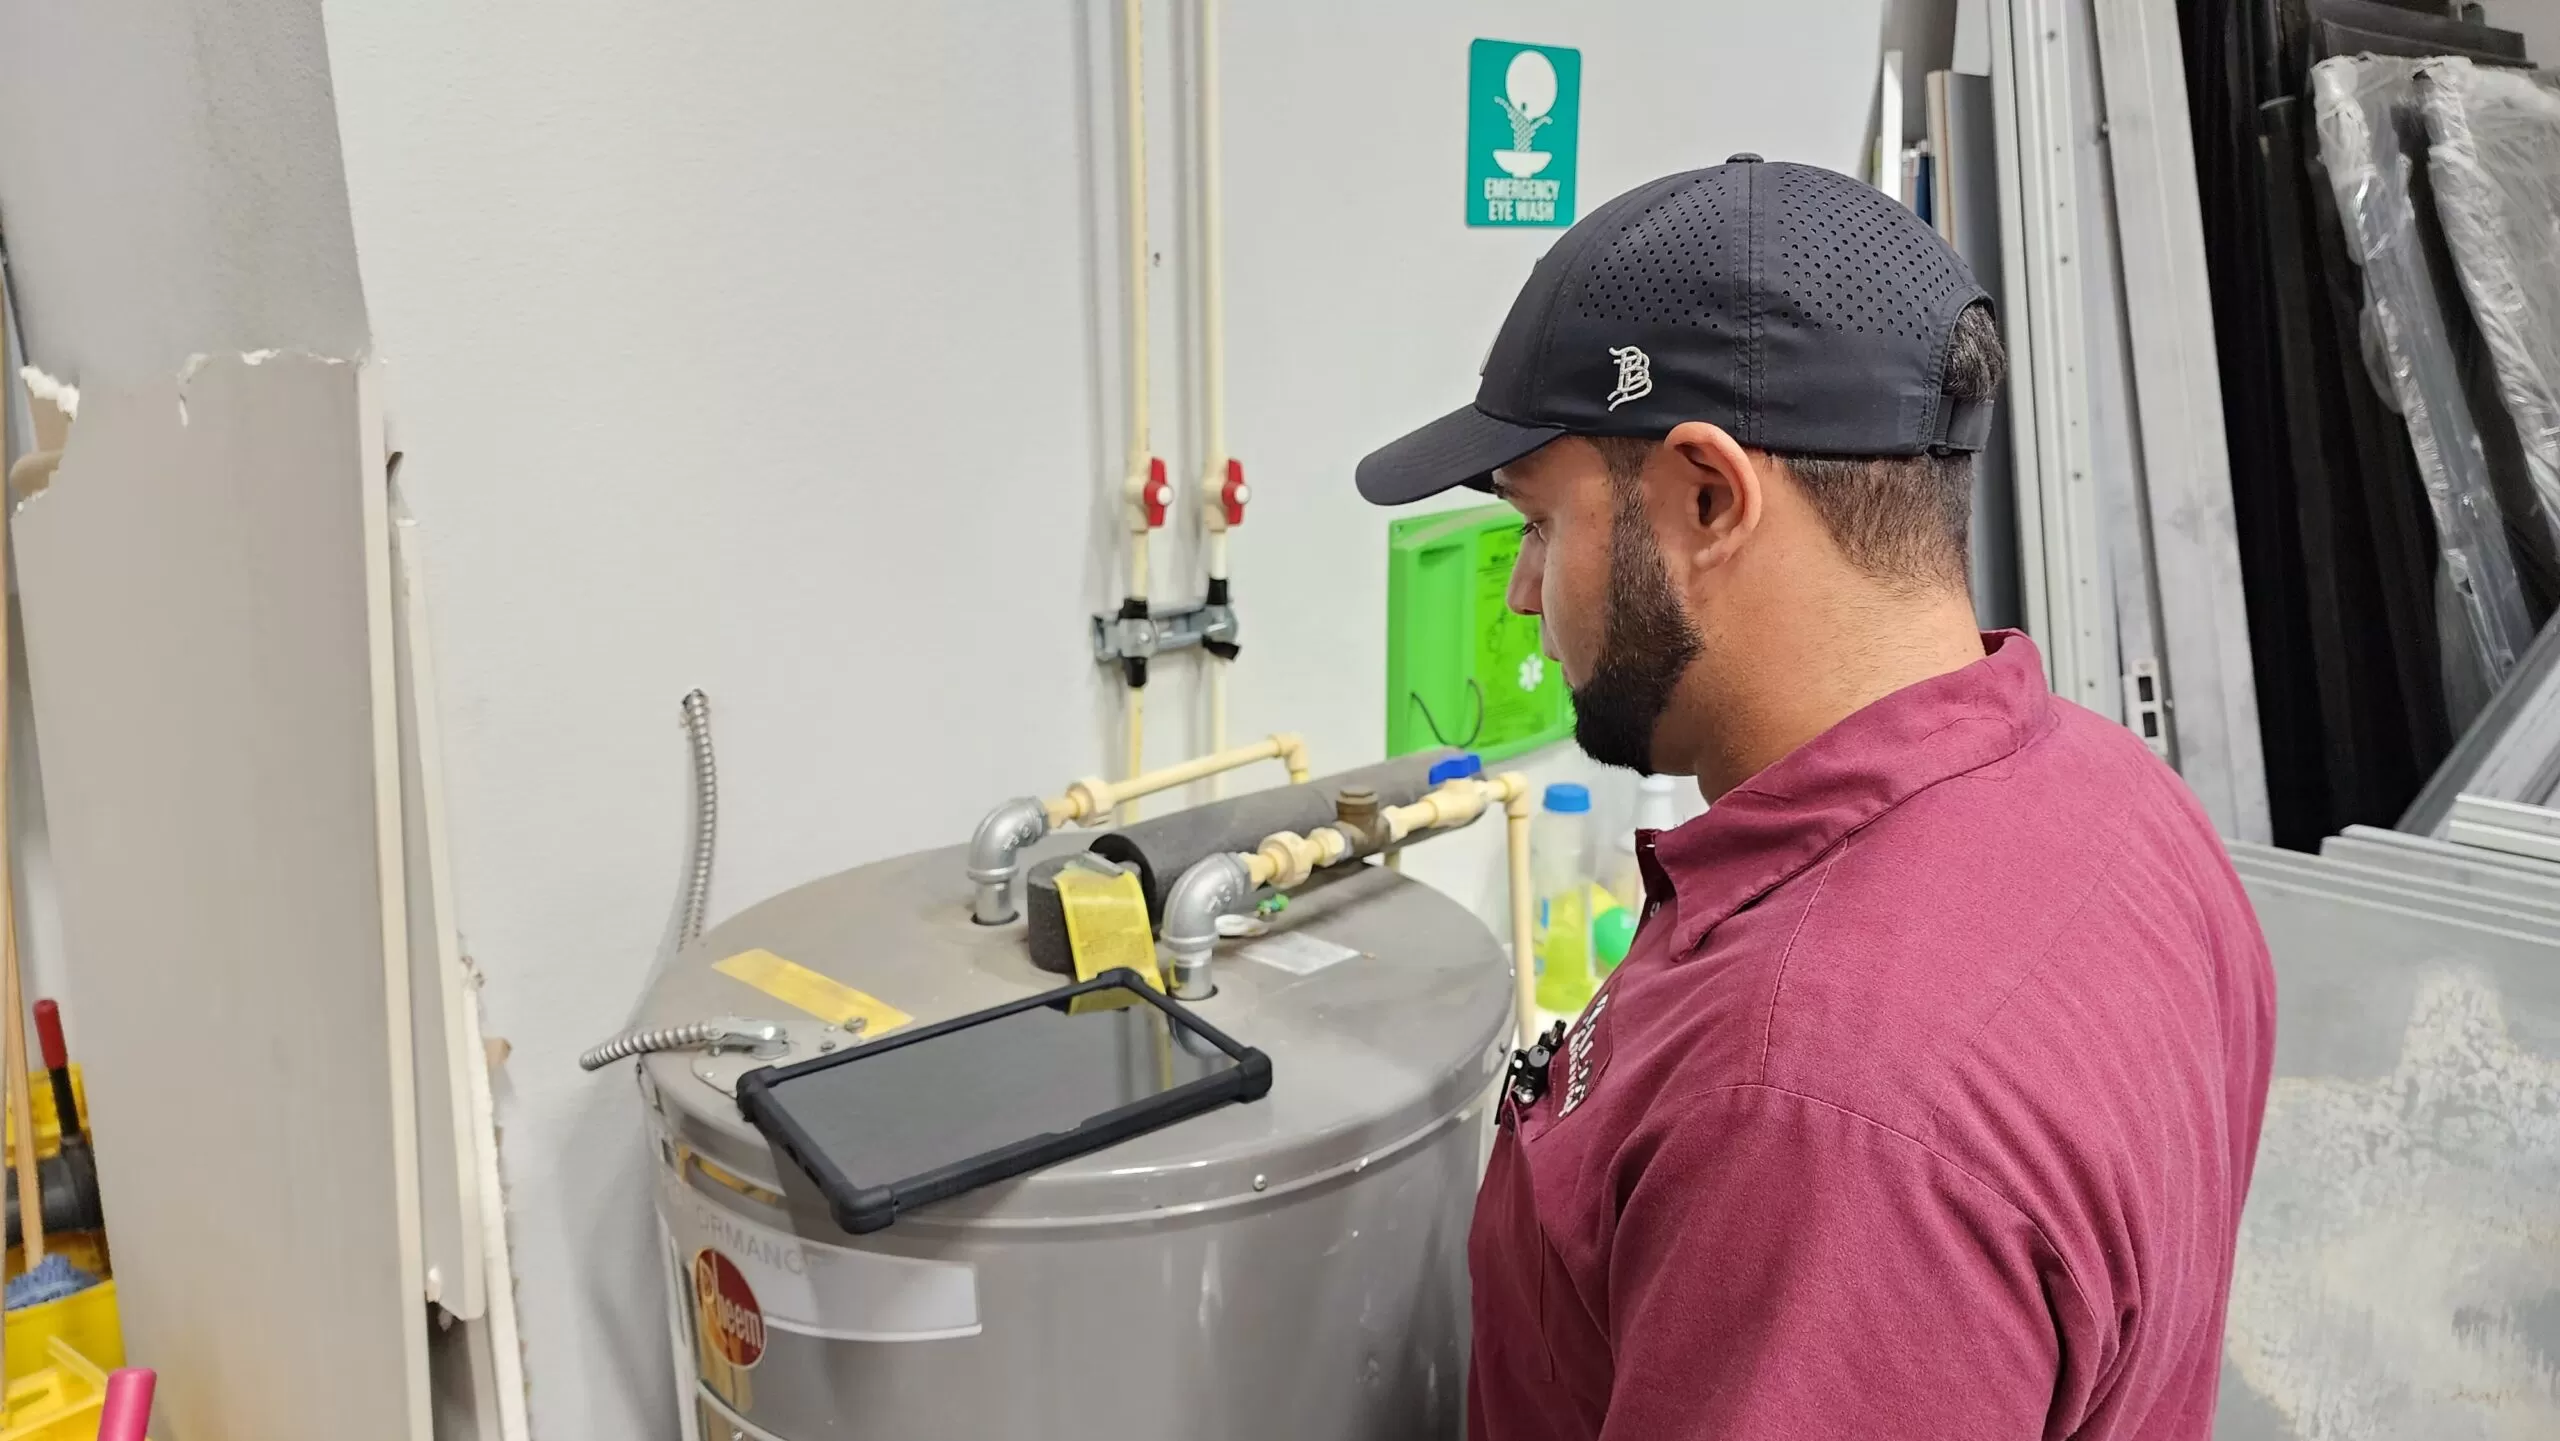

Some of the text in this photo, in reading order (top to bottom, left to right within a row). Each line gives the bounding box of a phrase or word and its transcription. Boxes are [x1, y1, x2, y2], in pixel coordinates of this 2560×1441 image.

[1484, 177, 1561, 201] EMERGENCY
[1488, 200, 1555, 222] EYE WASH
[700, 1251, 762, 1350] Rheem
